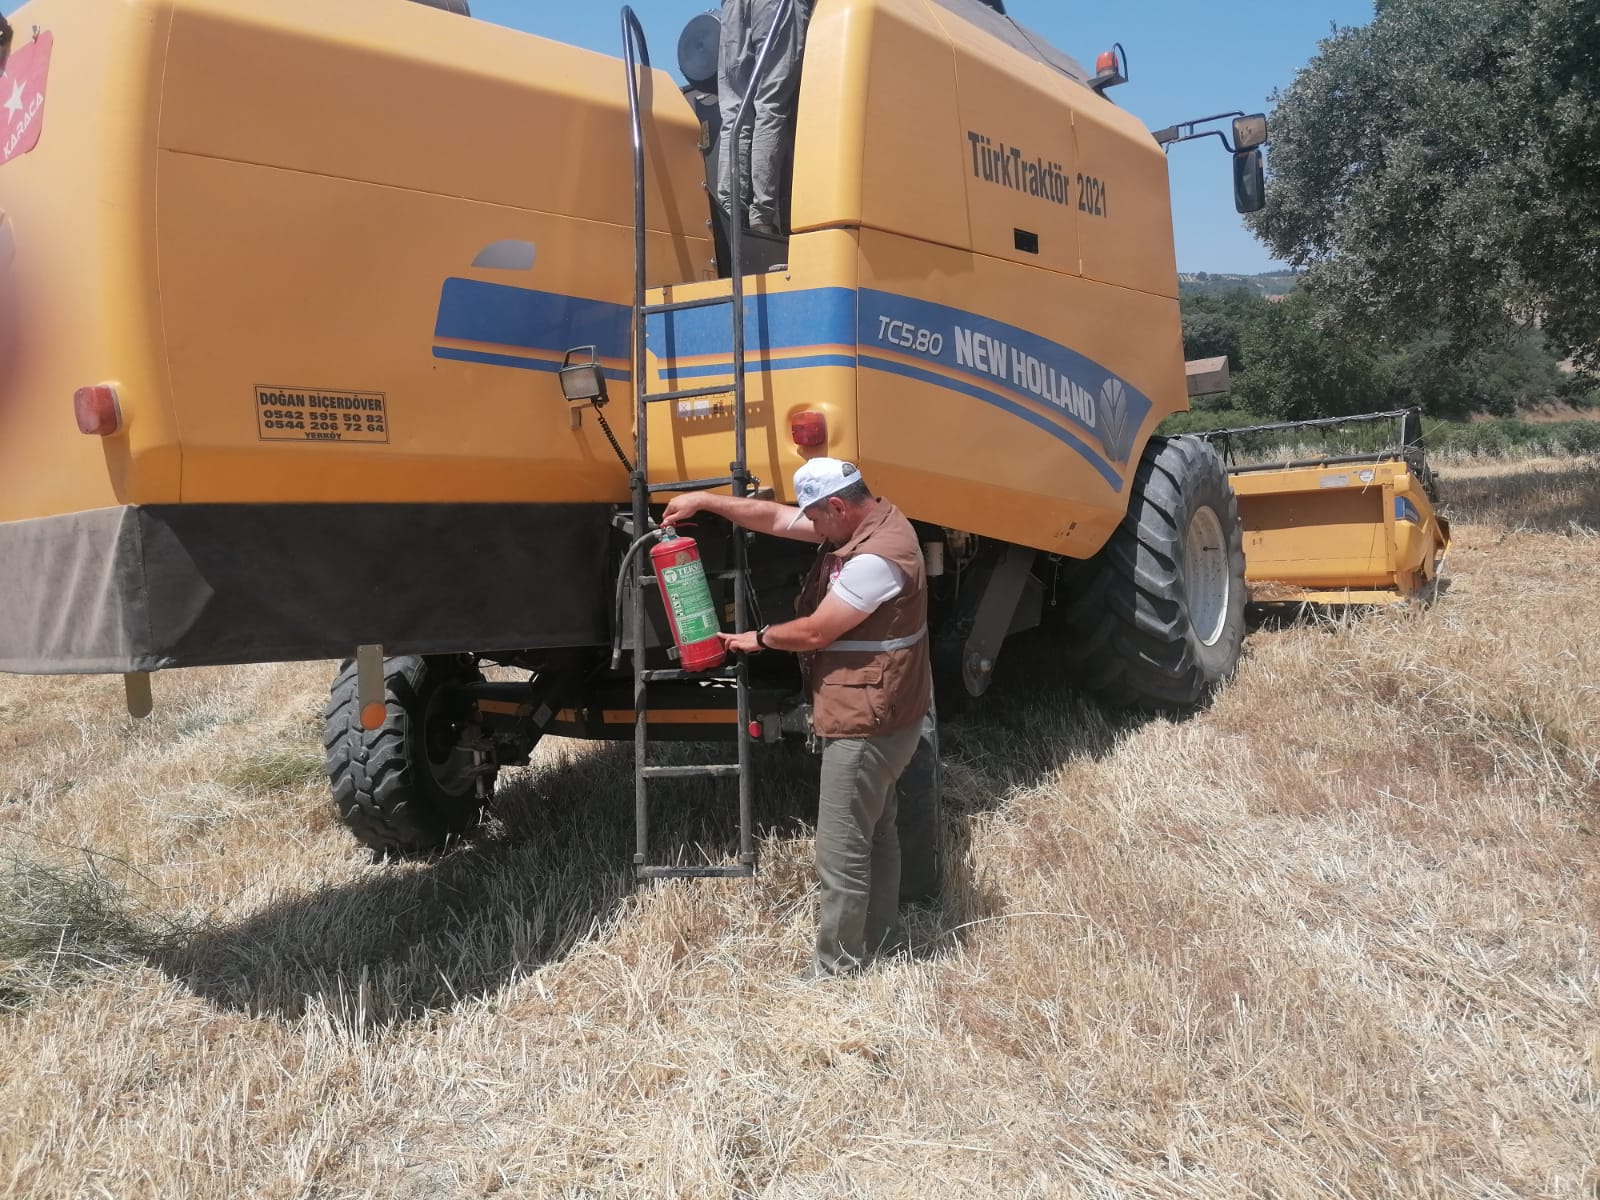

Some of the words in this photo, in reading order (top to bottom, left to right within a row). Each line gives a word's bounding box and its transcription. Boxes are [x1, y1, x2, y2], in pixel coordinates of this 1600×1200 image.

[2, 91, 45, 159] KARACA
[967, 130, 1070, 206] TürkTraktör
[1076, 172, 1107, 218] 2021
[877, 315, 943, 356] TC5.80
[954, 326, 1008, 379] NEW
[1011, 347, 1096, 428] HOLLAND
[259, 391, 305, 407] DOĞAN
[308, 393, 383, 412] BİÇERDÖVER
[263, 409, 304, 420] 0542
[309, 412, 338, 421] 595
[343, 414, 362, 422] 50
[366, 414, 384, 423] 82
[264, 420, 305, 430] 0544
[310, 421, 339, 431] 206
[343, 422, 362, 432] 72
[367, 424, 384, 432] 64
[304, 431, 342, 440] YERKÖY
